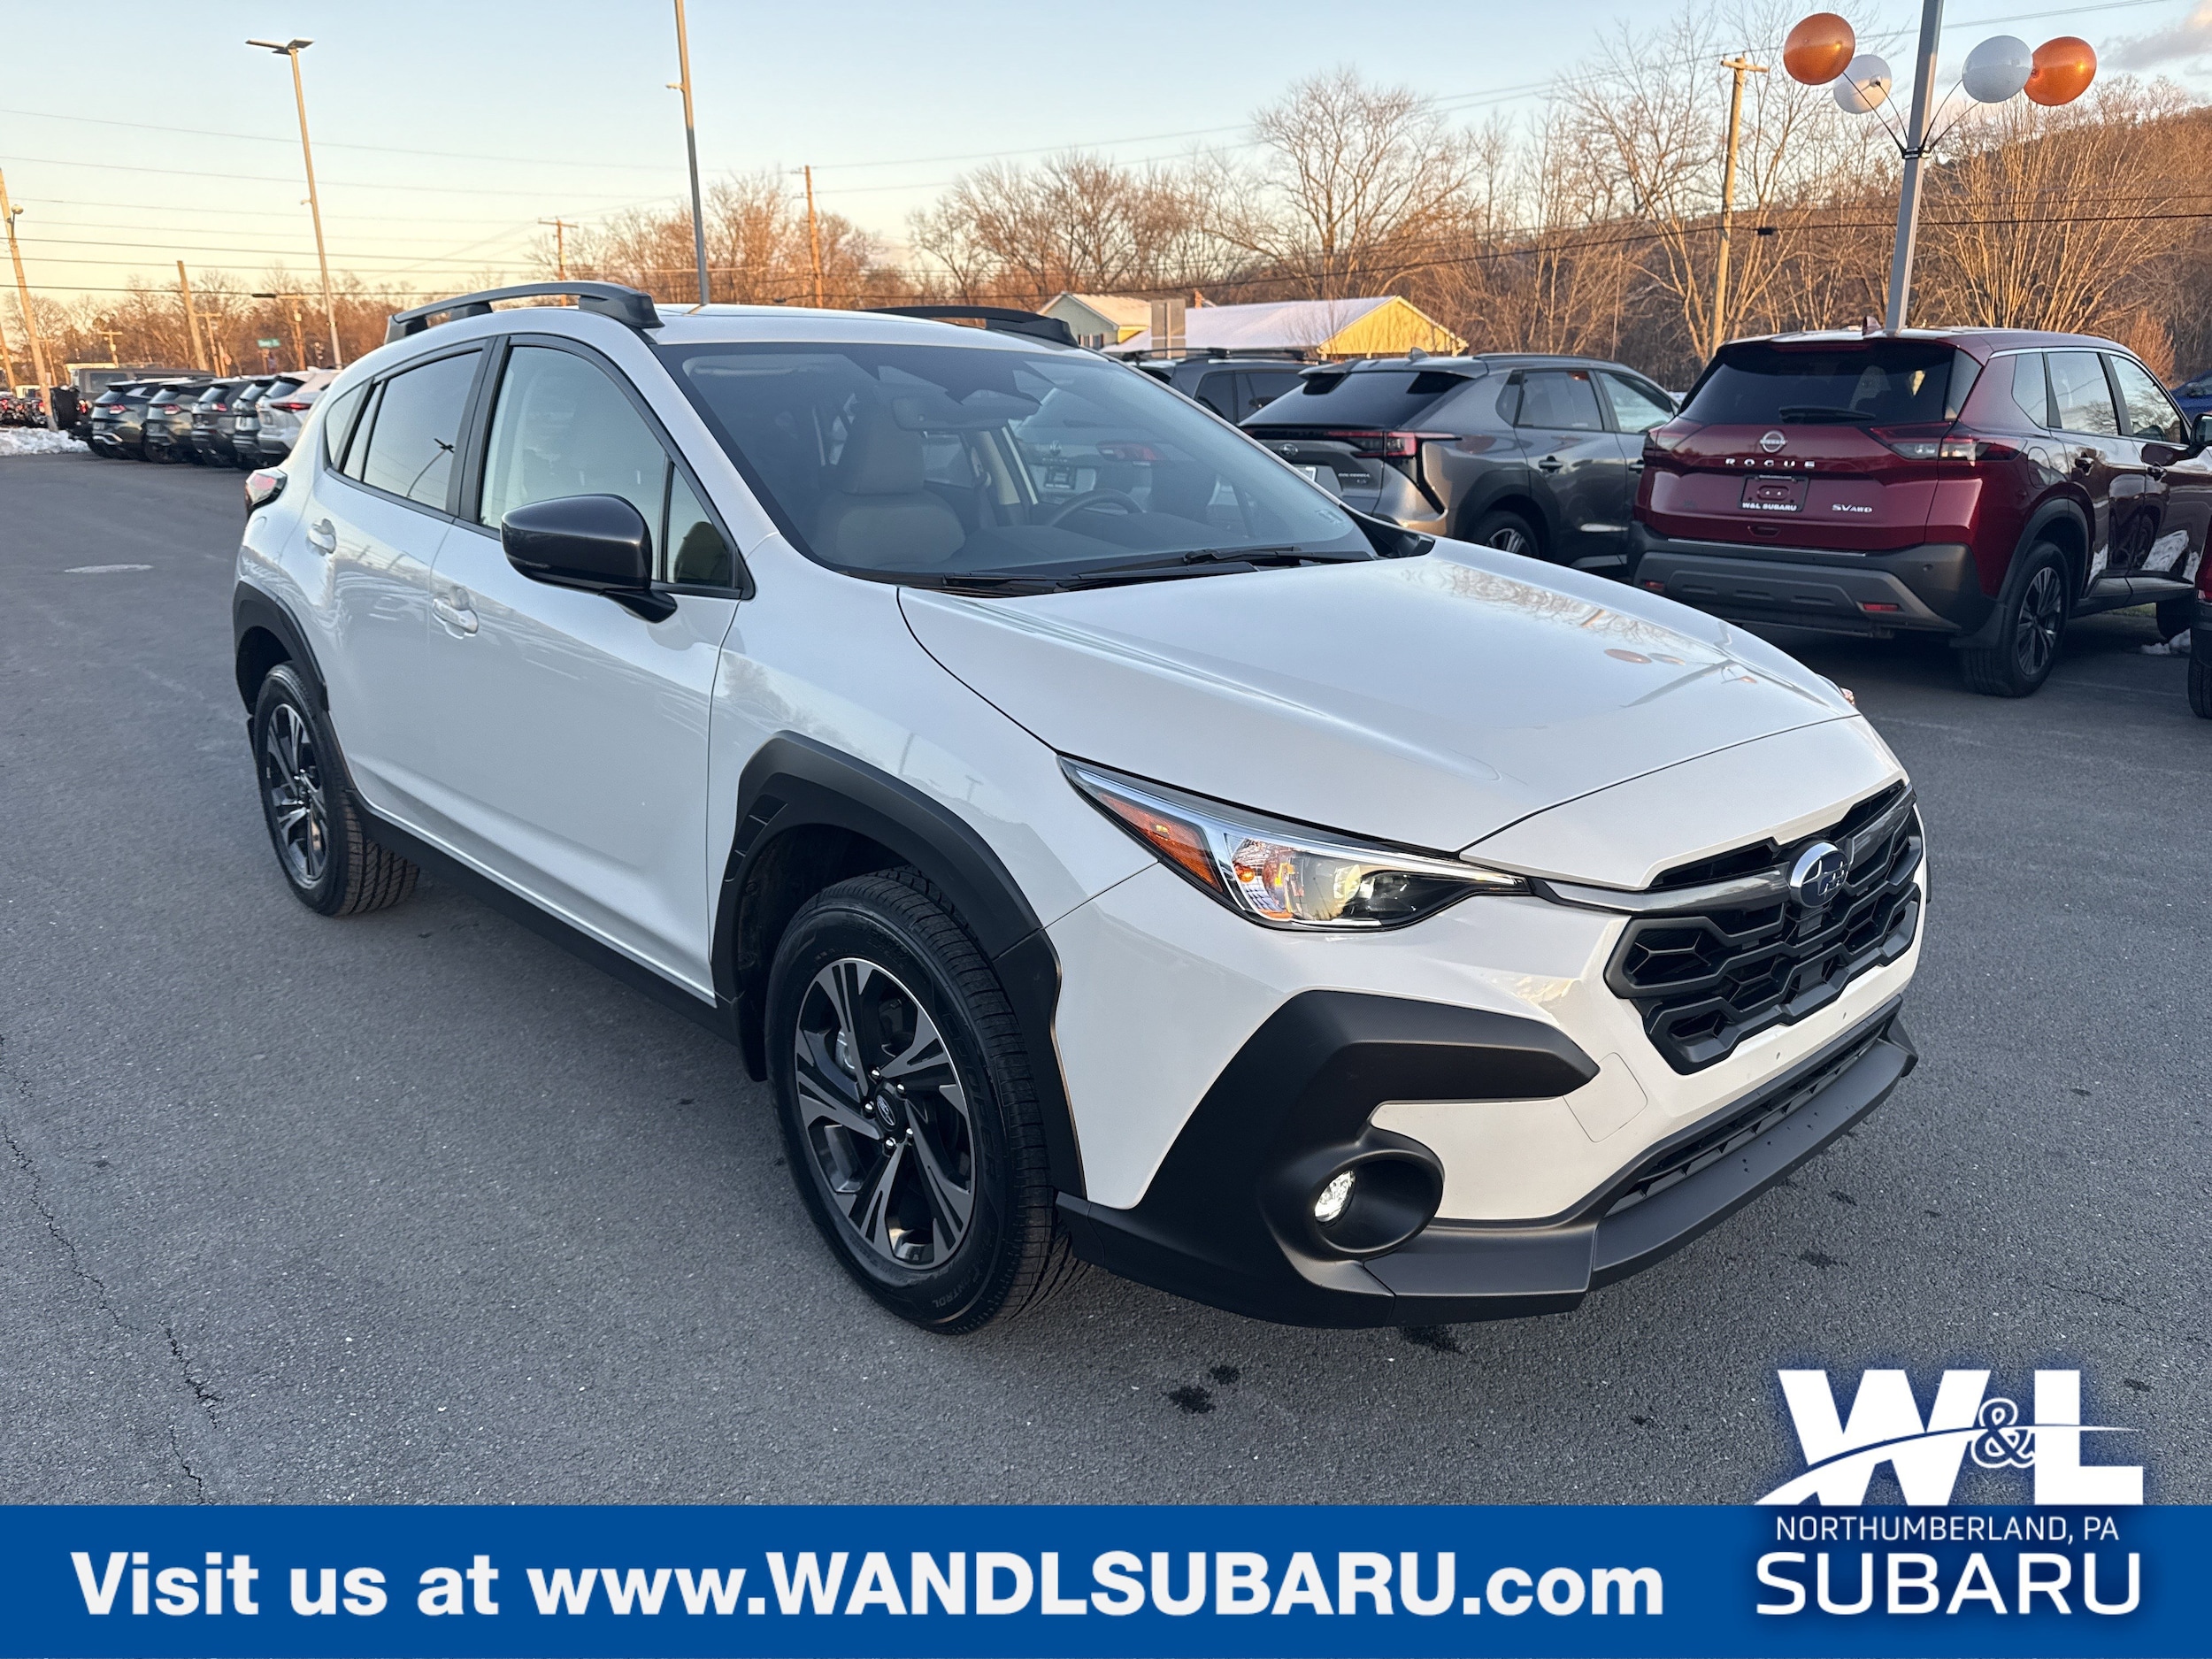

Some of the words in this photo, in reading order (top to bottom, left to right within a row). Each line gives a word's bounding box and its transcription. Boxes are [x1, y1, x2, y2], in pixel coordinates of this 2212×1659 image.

[1725, 457, 1816, 468] ROGUE
[1762, 503, 1797, 511] SUBARU
[941, 1012, 998, 1182] COOPER
